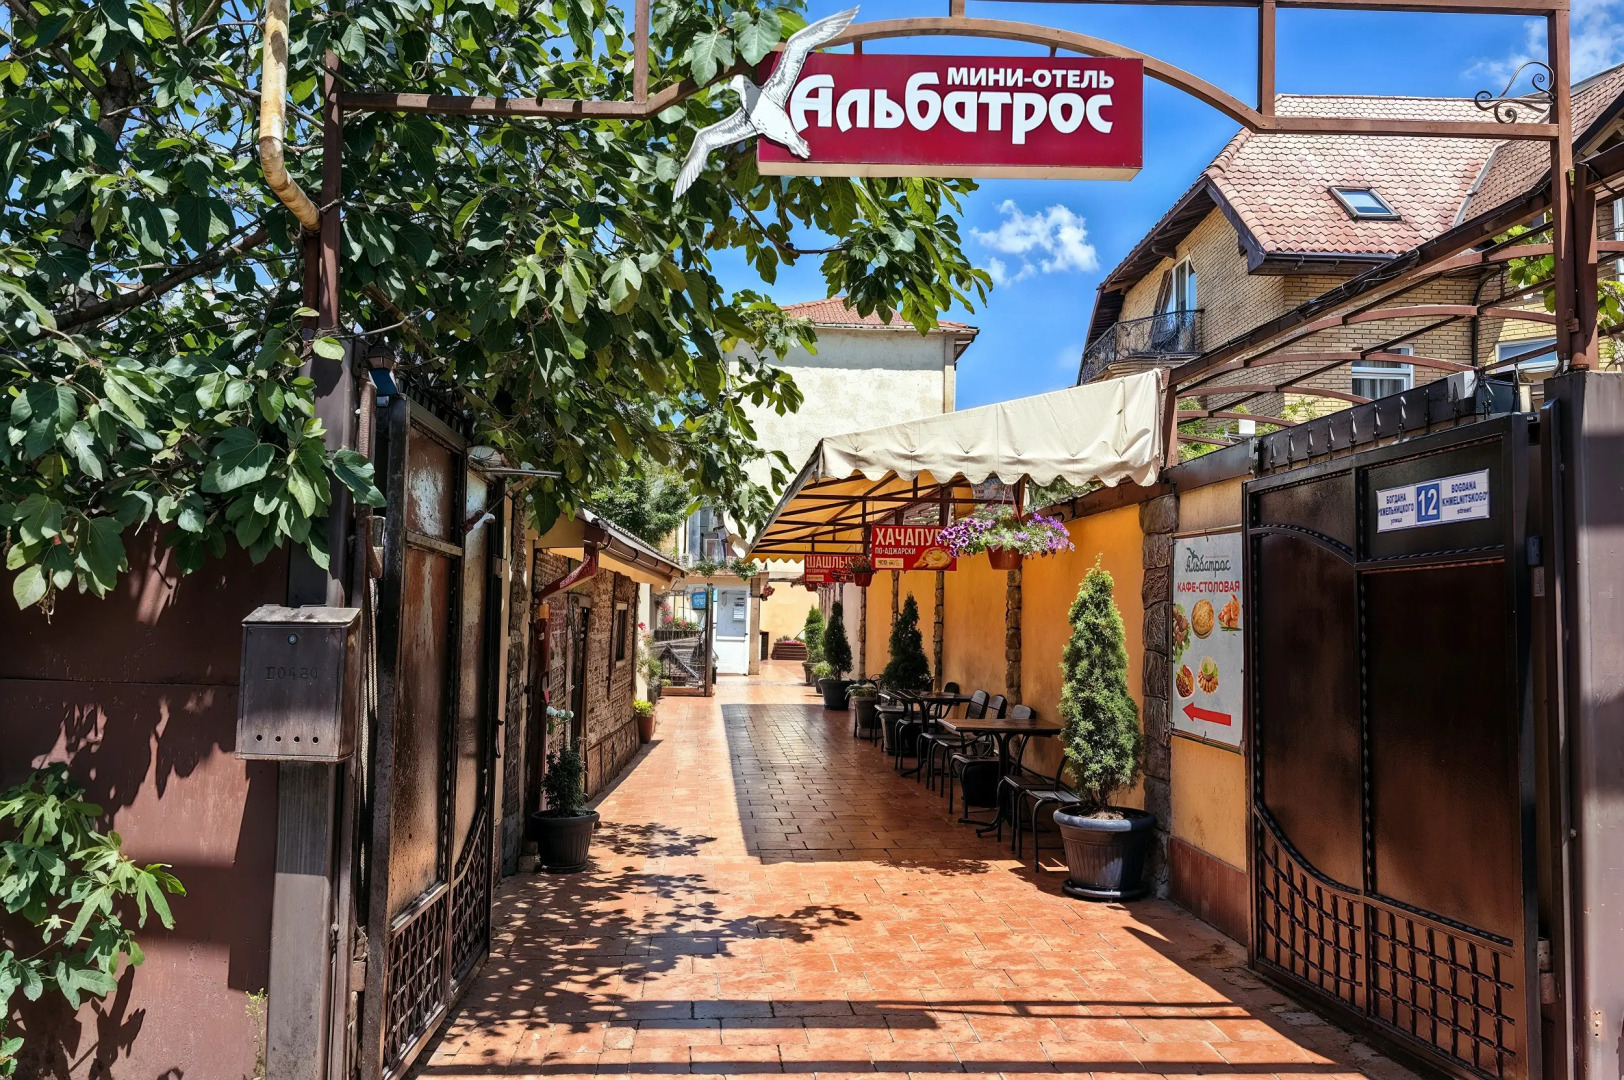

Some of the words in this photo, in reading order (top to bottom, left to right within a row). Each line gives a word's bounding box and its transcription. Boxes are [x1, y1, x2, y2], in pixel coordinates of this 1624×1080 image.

[947, 66, 1114, 89] МИНИ-ОТЕЛЬ
[790, 72, 1114, 145] Альбатрос
[1451, 481, 1476, 493] BOGDANA
[1386, 493, 1406, 504] БОГДАНА
[1418, 488, 1438, 516] 12
[1457, 507, 1471, 515] street
[875, 528, 949, 546] ХАЧАПУР
[1185, 554, 1231, 578] Альбатрос
[1177, 580, 1240, 593] КАФЕ-СТОЛОВАЯ
